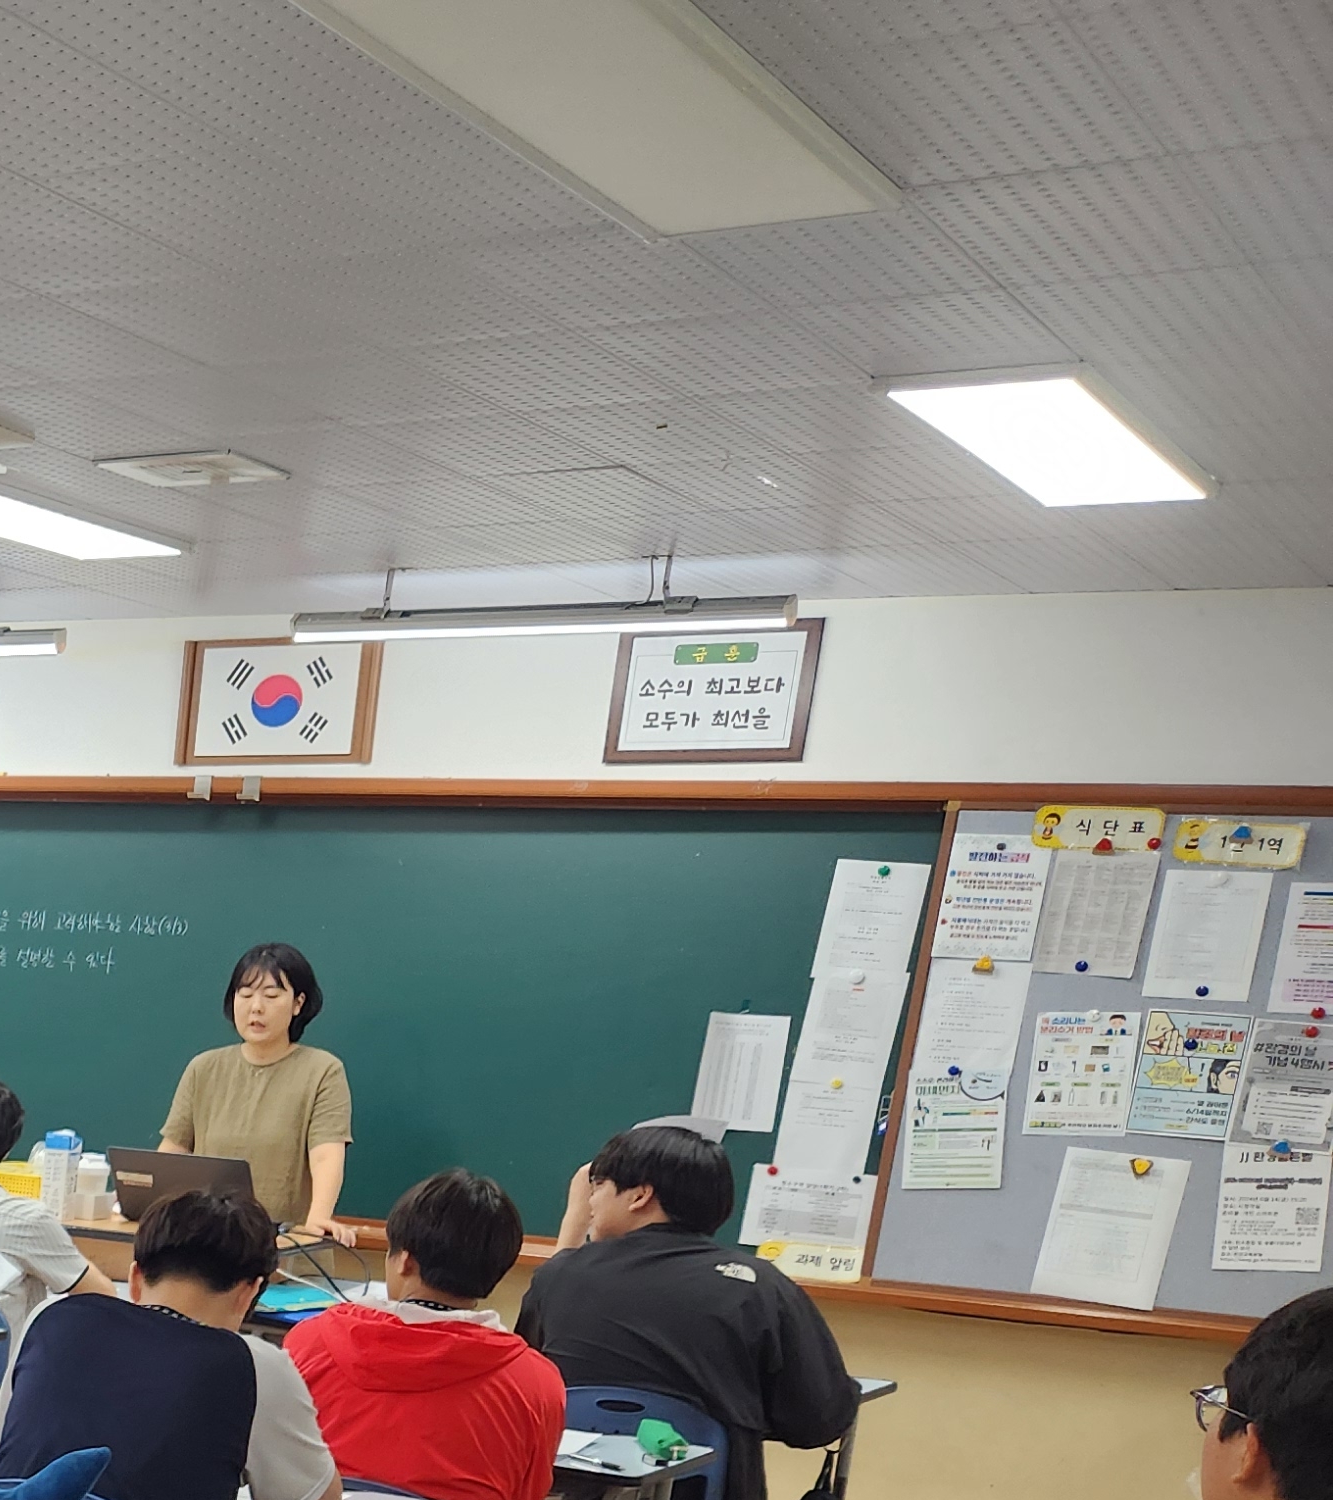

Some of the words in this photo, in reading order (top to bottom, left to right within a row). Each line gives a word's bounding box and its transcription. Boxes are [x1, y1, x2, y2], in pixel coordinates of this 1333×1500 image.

[692, 646, 707, 662] 급
[724, 644, 740, 662] 훈
[639, 678, 693, 700] 소수의
[705, 676, 785, 696] 최고보다
[642, 711, 700, 731] 모두가
[711, 707, 771, 730] 최선을
[1076, 819, 1091, 836] 식
[1103, 820, 1119, 836] 단
[1129, 821, 1146, 833] 표
[1258, 837, 1284, 855] 1역
[18, 909, 46, 931] 위해
[16, 947, 55, 968] 설명할
[62, 951, 76, 972] 수
[85, 947, 115, 975] 있다
[1265, 1056, 1288, 1068] 기념
[795, 1254, 822, 1268] 과제
[829, 1256, 856, 1272] 알림
